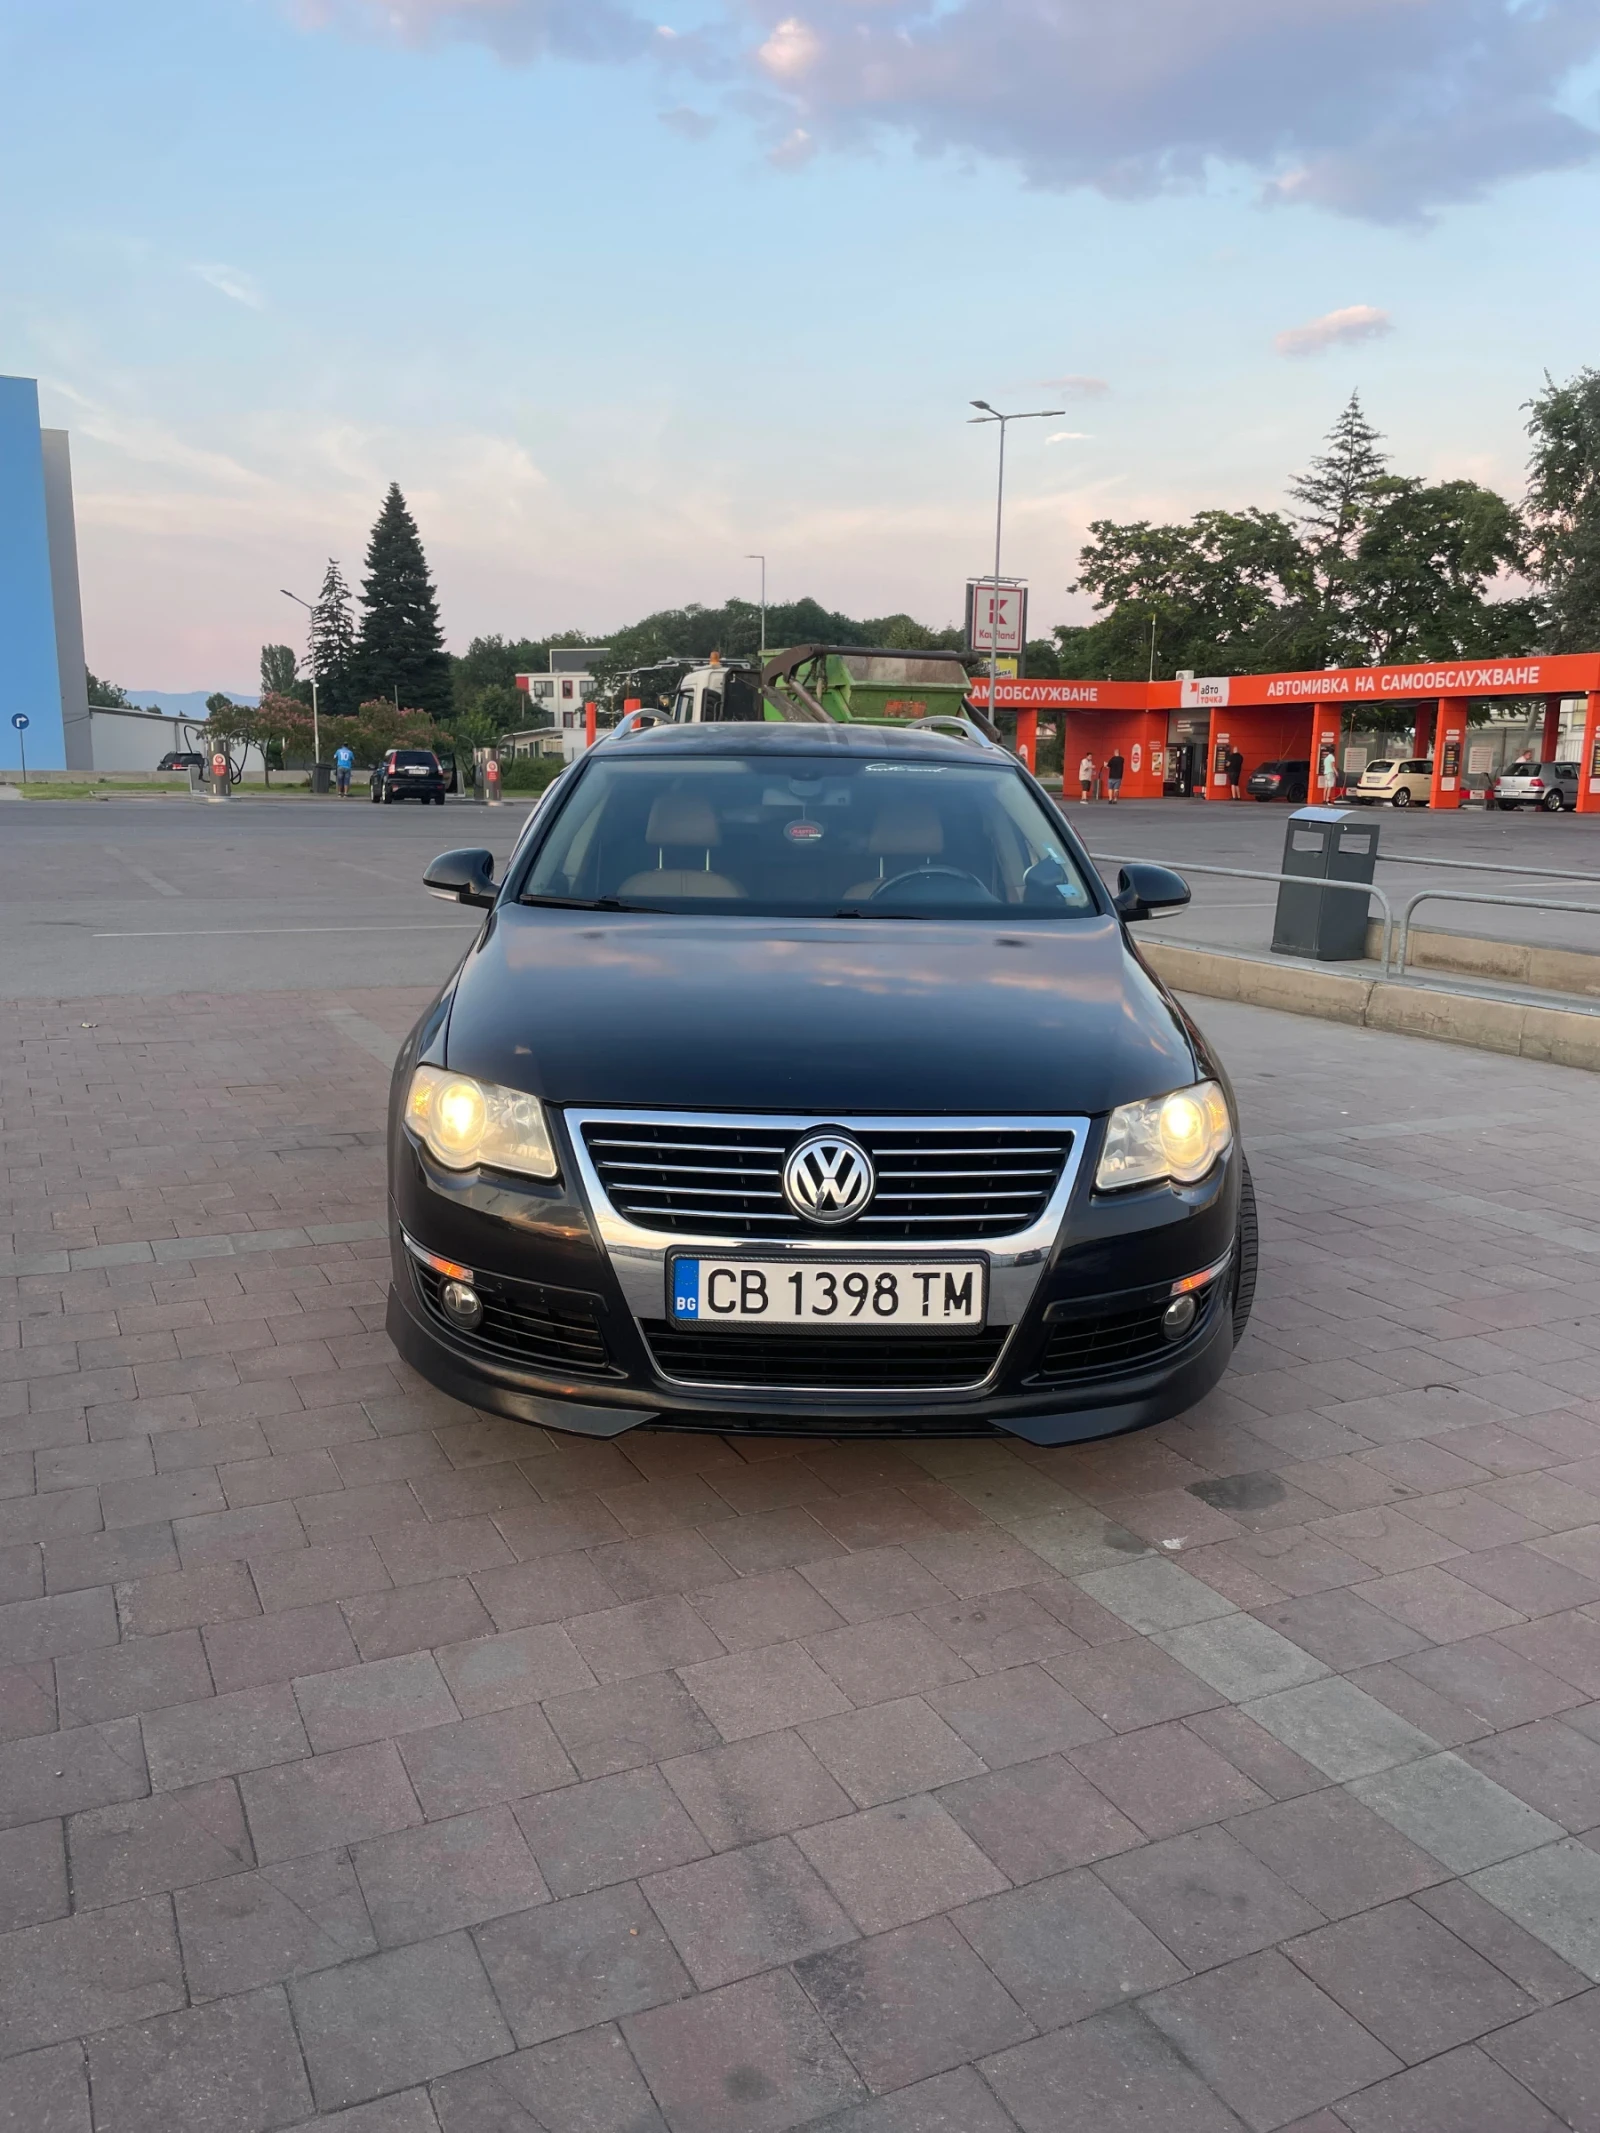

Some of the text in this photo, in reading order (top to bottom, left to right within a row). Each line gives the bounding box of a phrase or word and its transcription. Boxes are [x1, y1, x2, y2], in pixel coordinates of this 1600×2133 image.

[1267, 666, 1541, 697] АВТОМИВКА НА САМООБСЛУЖВАНЕ
[970, 685, 1099, 702] АМООБСЛУЖВАНЕ
[1200, 696, 1223, 704] точка
[340, 751, 350, 761] 10
[676, 1268, 973, 1317] BG CB 1398 TM
